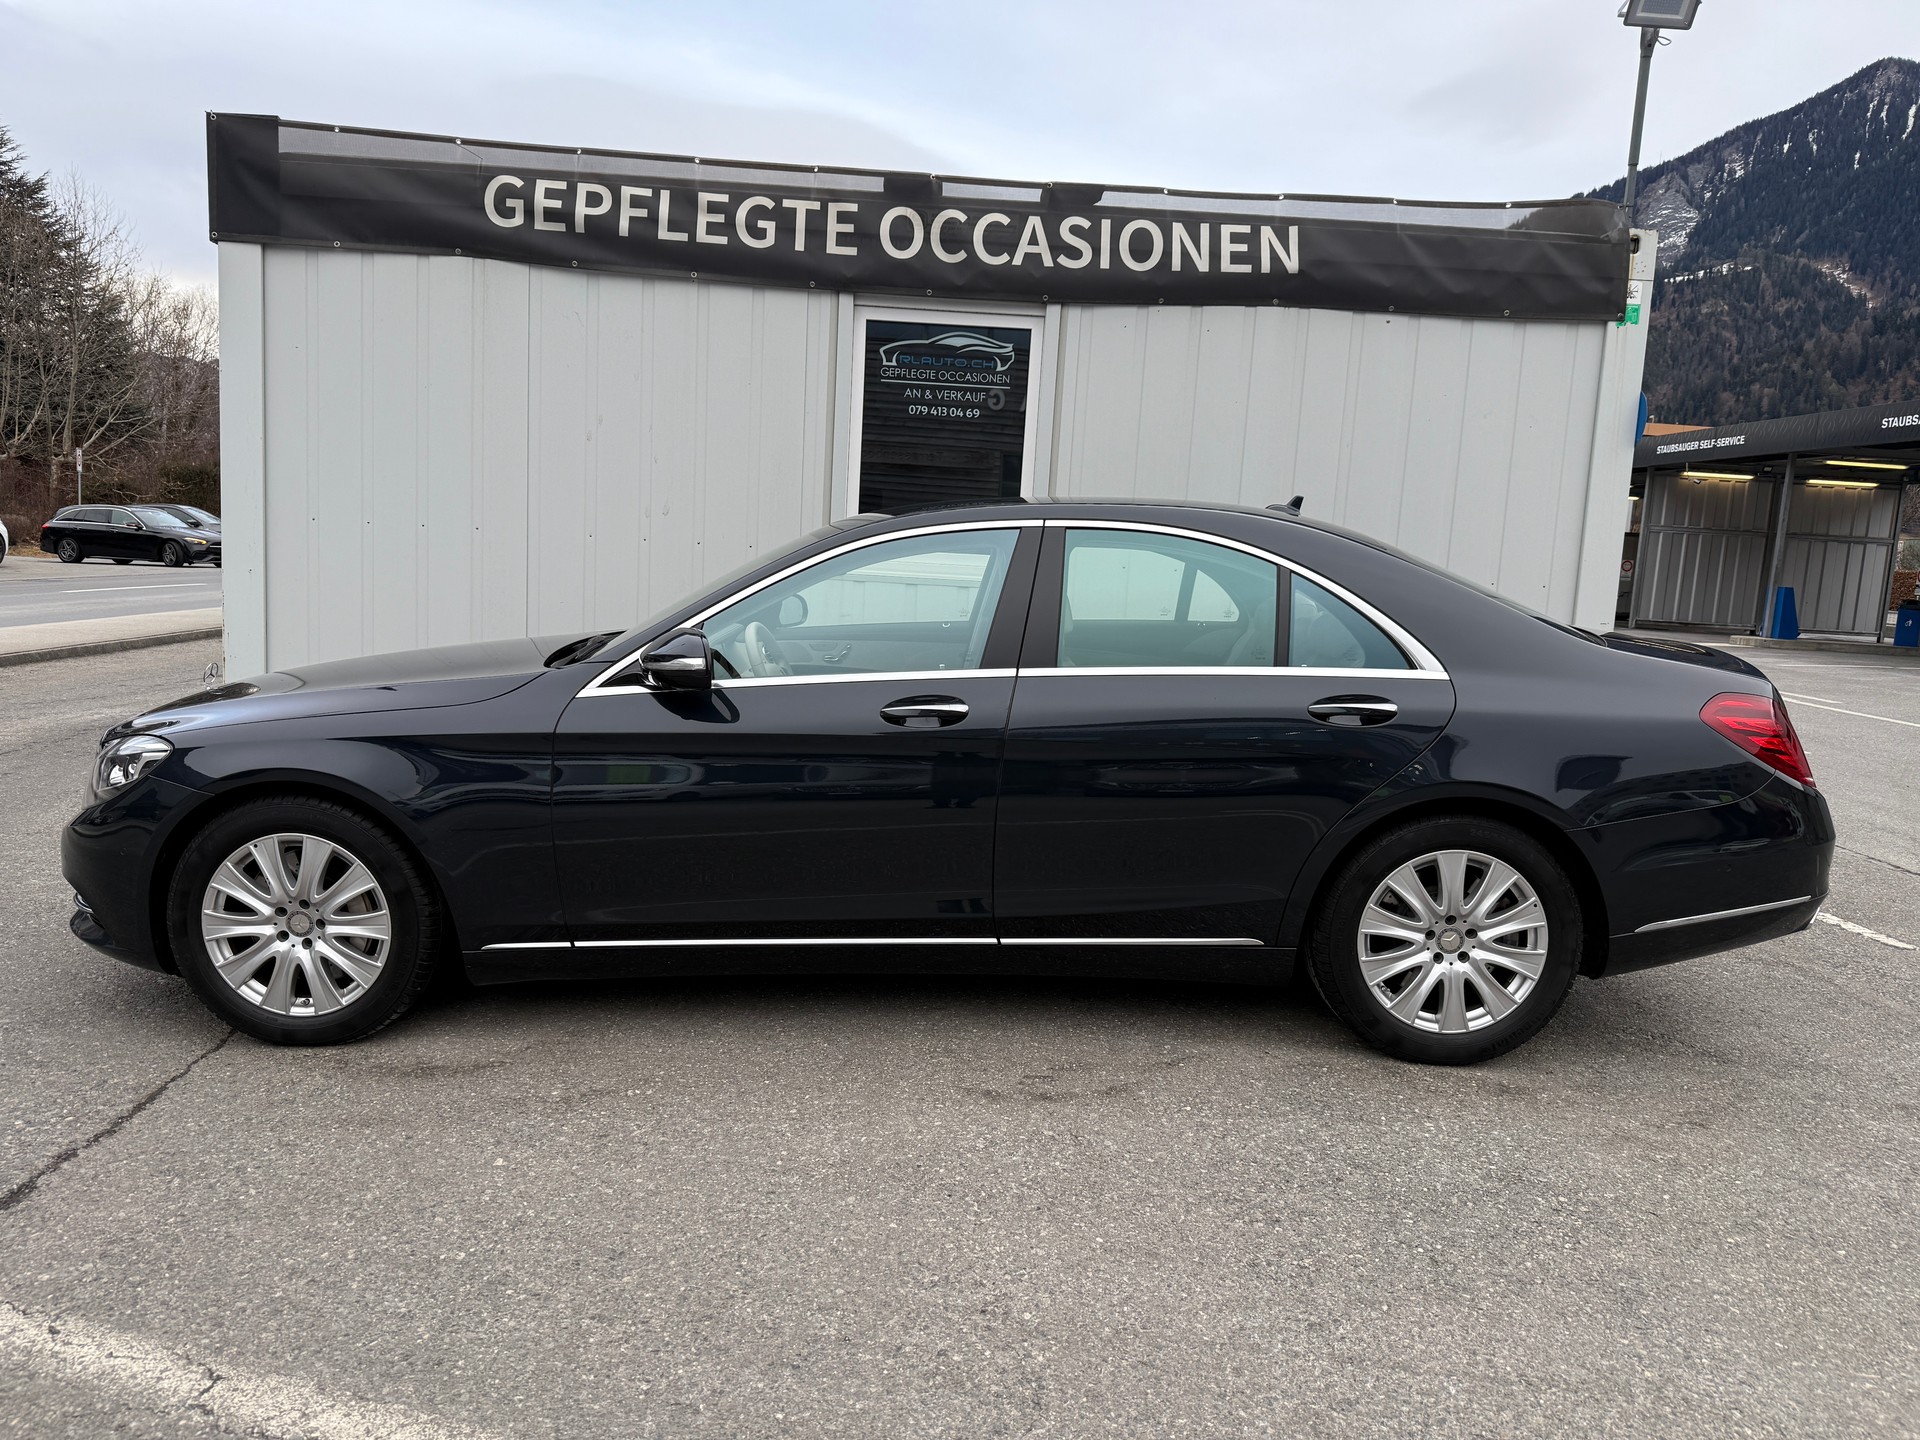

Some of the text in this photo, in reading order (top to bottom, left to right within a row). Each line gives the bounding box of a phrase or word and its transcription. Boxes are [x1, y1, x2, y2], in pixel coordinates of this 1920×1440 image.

[483, 174, 1299, 274] GEPFLEGTE OCCASIONEN
[900, 355, 994, 368] RLAUTO.CH
[880, 367, 1010, 383] GEPFLEGTE OCCASIONEN
[903, 387, 986, 402] AN & VERKAUF
[908, 404, 980, 419] 079 413 04 69
[1881, 414, 1920, 429] STAUBS
[1656, 435, 1746, 455] STAUBSAUGER SELF-SERVICE
